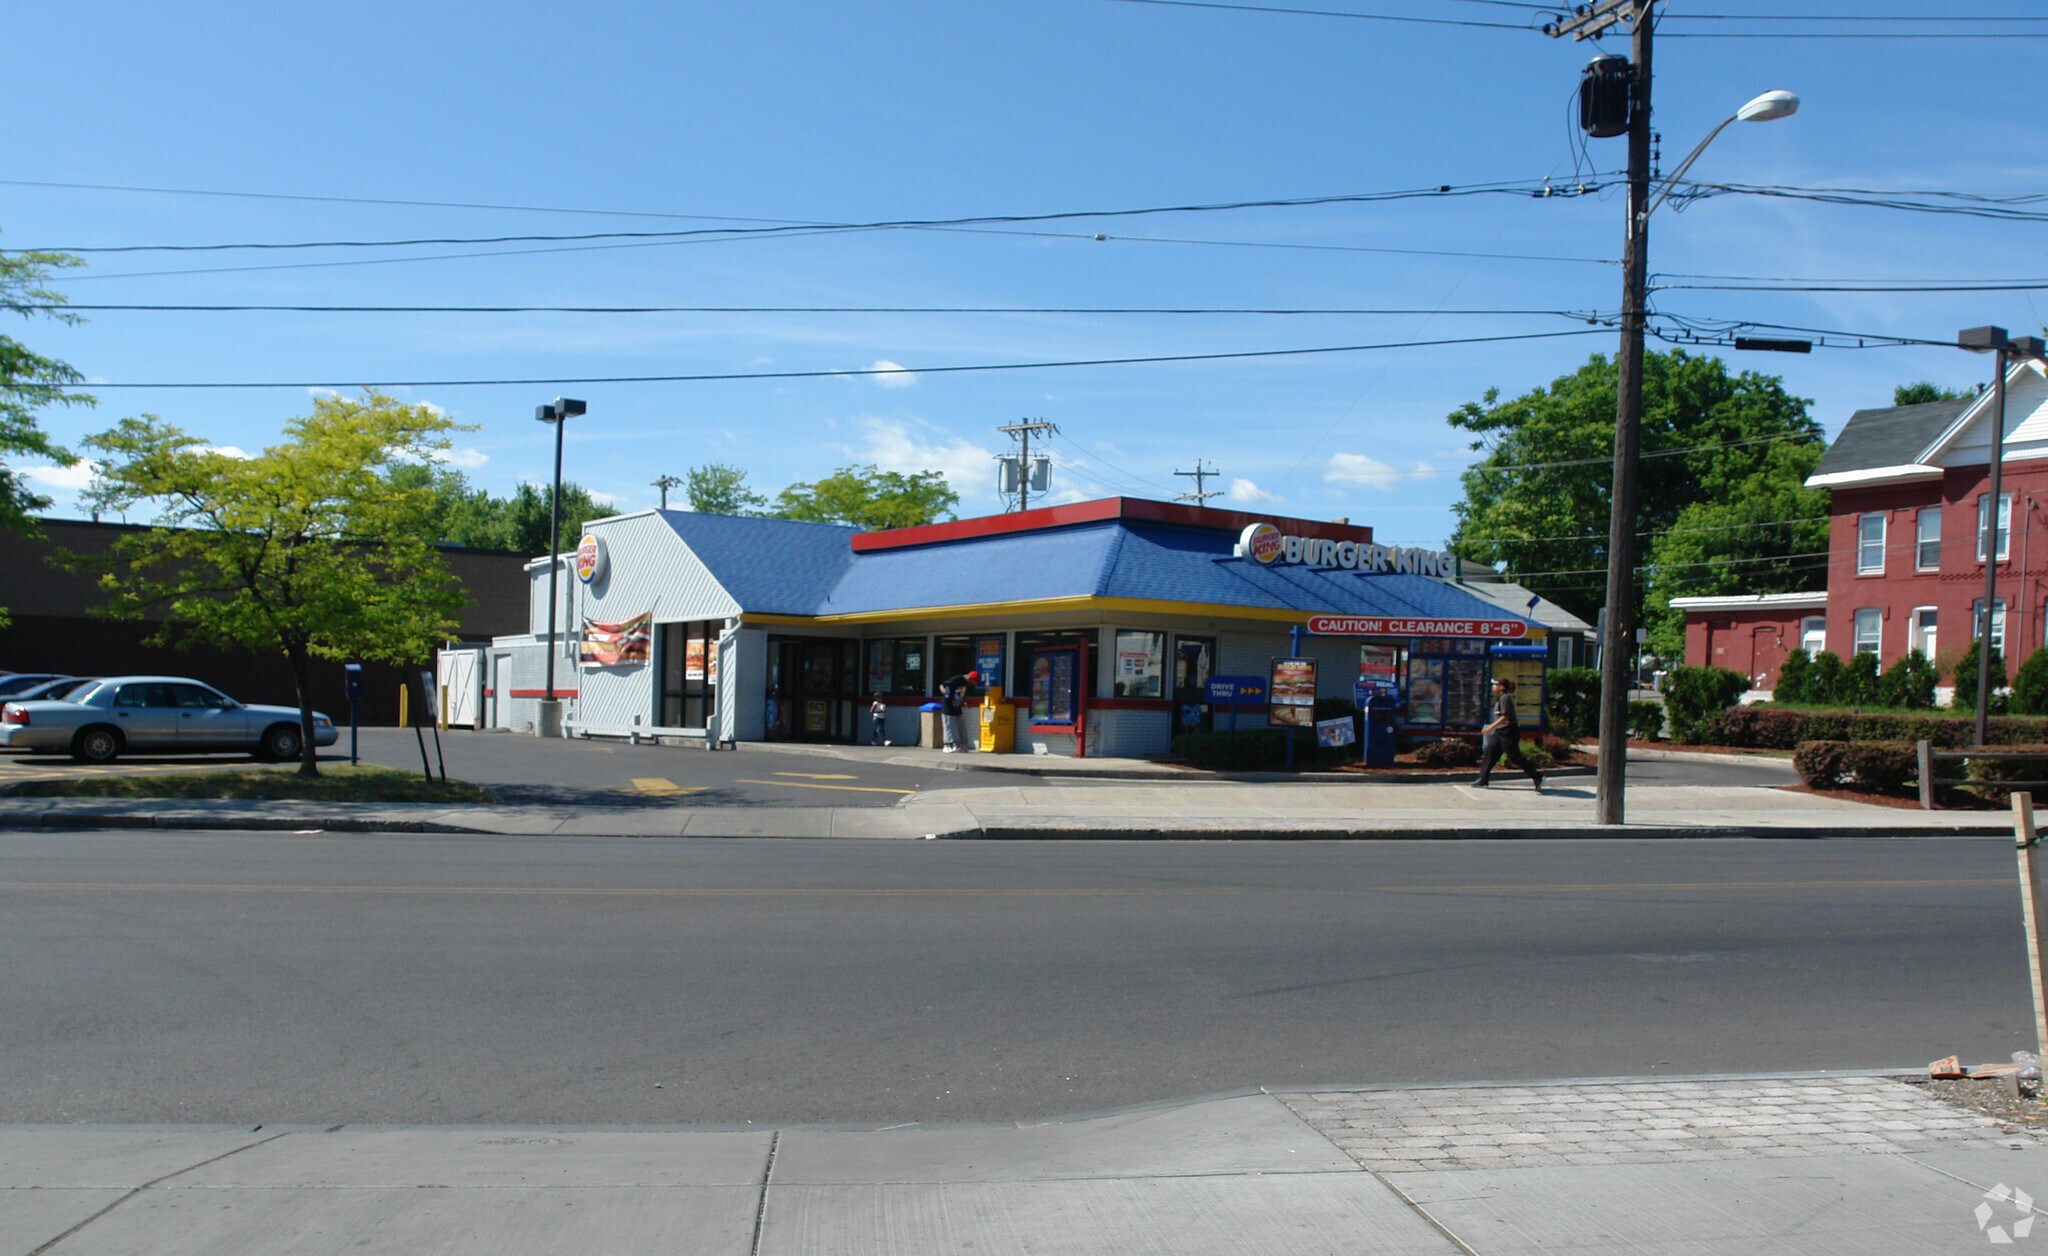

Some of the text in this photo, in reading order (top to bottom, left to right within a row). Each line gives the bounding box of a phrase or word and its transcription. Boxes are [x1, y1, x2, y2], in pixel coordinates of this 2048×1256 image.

[1252, 532, 1280, 545] BURGER
[1252, 542, 1280, 557] KING
[1285, 536, 1455, 577] BURGER KING
[1318, 619, 1518, 635] CAUTION! CLEARANCE 8'-6"
